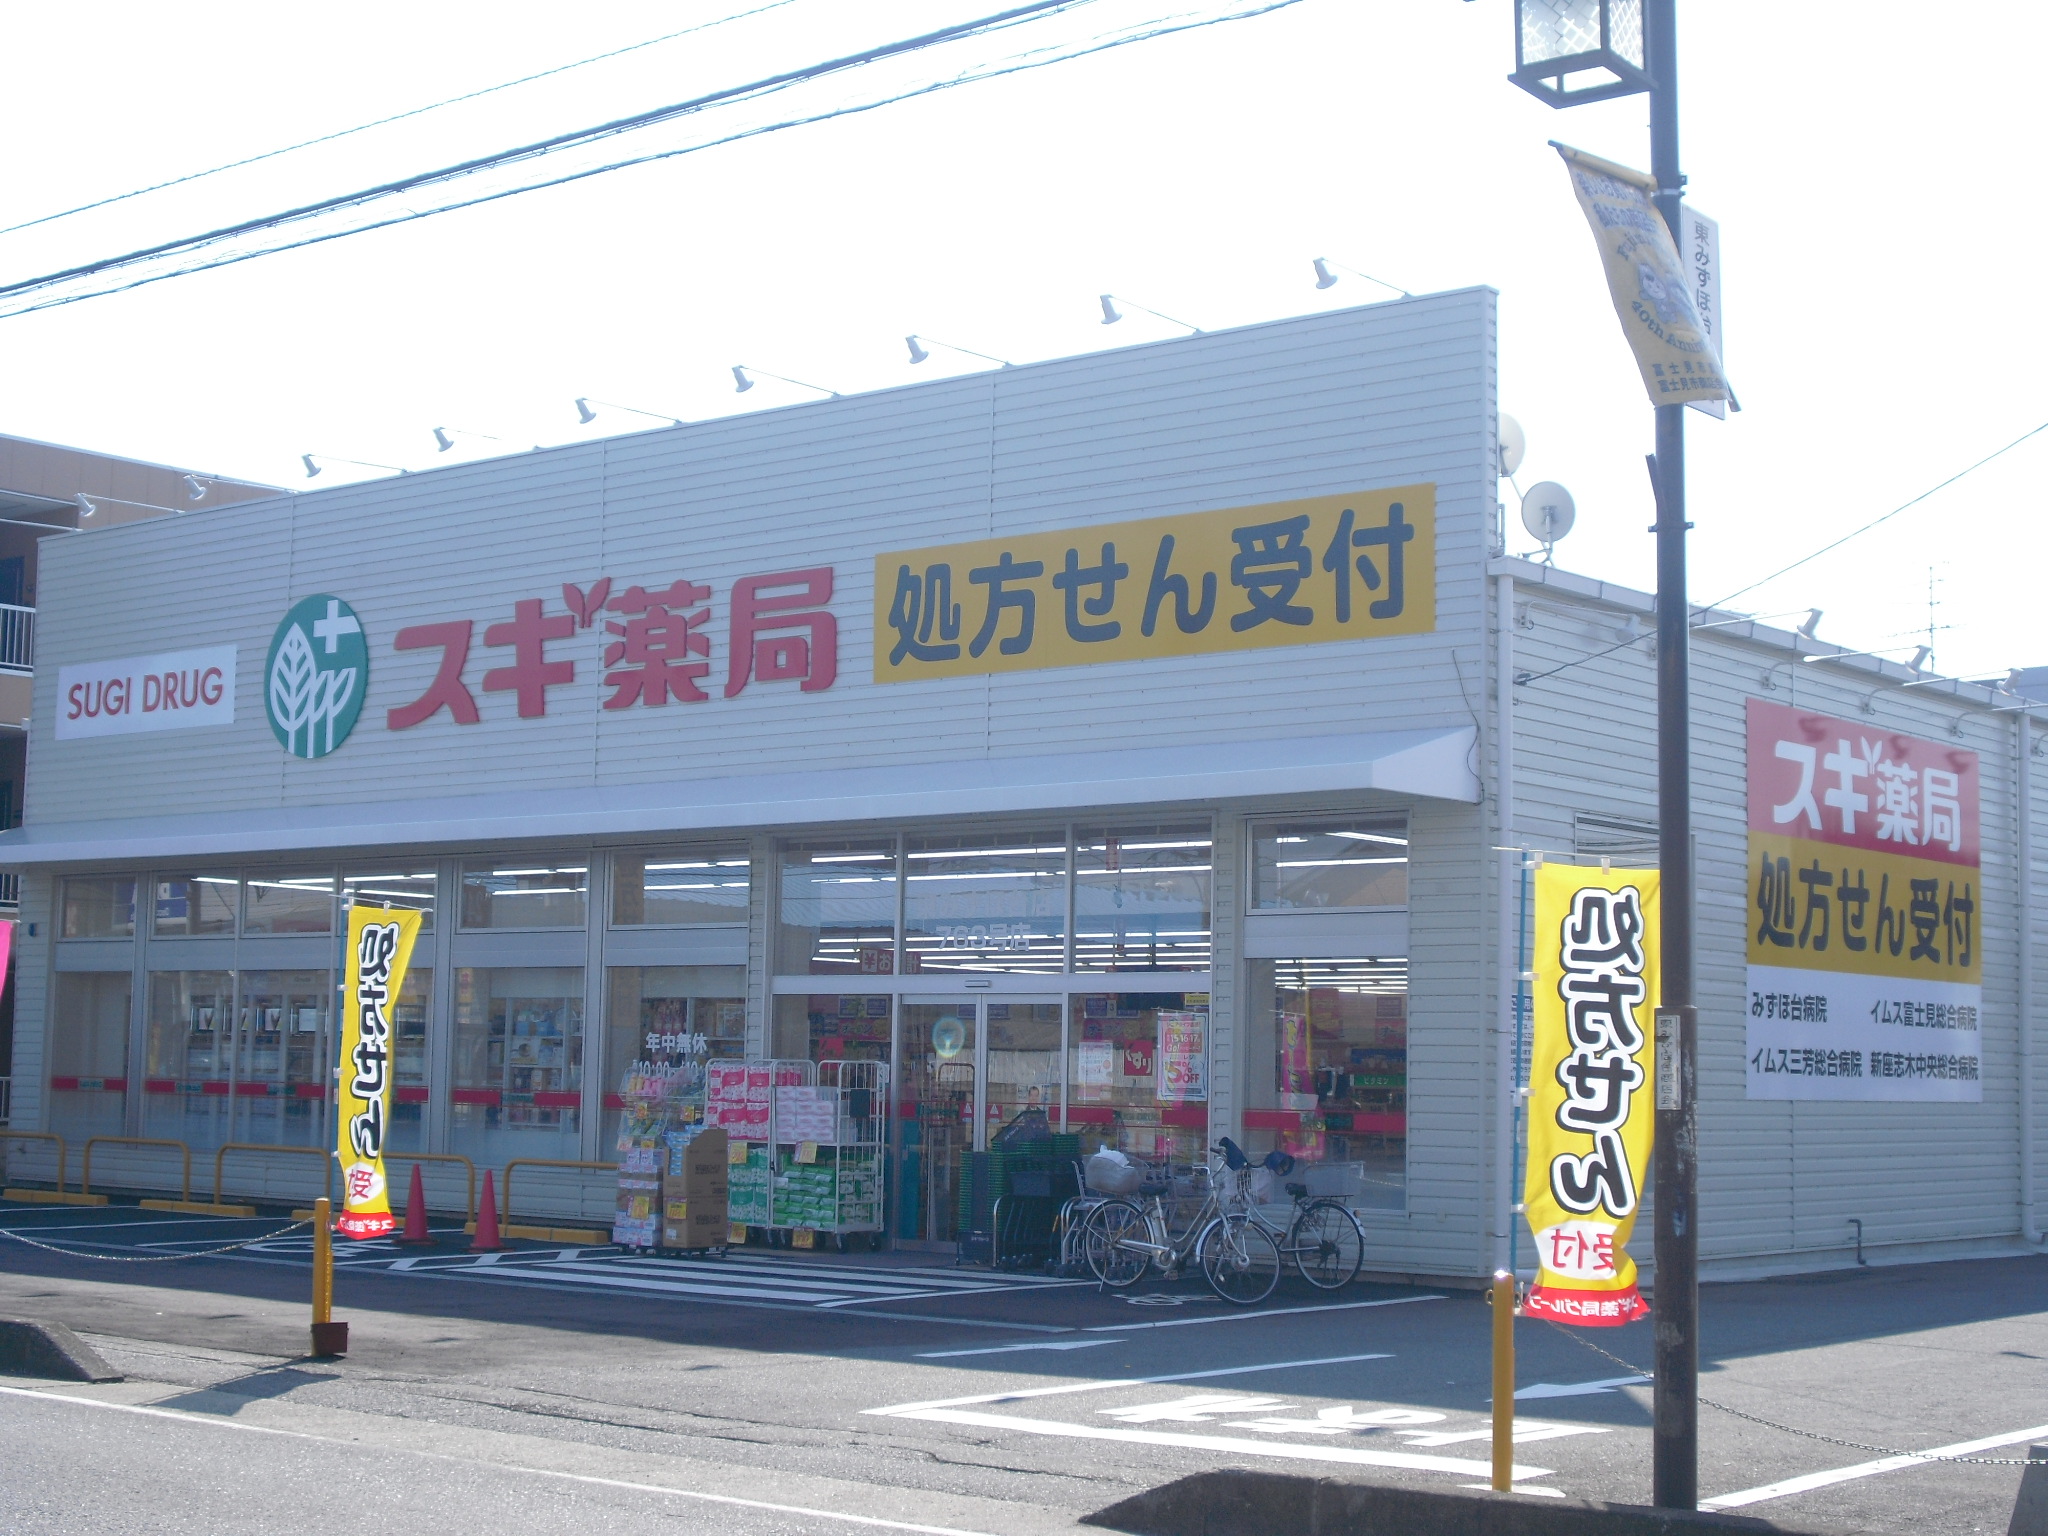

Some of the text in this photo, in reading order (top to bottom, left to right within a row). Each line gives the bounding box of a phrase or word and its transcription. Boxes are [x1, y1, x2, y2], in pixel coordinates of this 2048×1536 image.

[1631, 300, 1664, 340] 40th
[887, 502, 1415, 667] 処方せん受付
[387, 567, 837, 730] スギ薬局
[67, 667, 223, 720] SUGI DRUG
[1773, 735, 1961, 852] スギ薬局
[1757, 851, 1975, 967] 処方せん受付
[935, 922, 1031, 952] 763号店
[879, 952, 919, 974] お計
[1751, 991, 1977, 1032] みずほ台病院 イムス富士見総合病院
[645, 1032, 708, 1054] 年中無休
[1183, 1073, 1200, 1084] OFF
[1363, 1077, 1389, 1085] ビタミン
[1751, 1048, 1978, 1081] イムス三芳総合病院 新座志木中央総合病院
